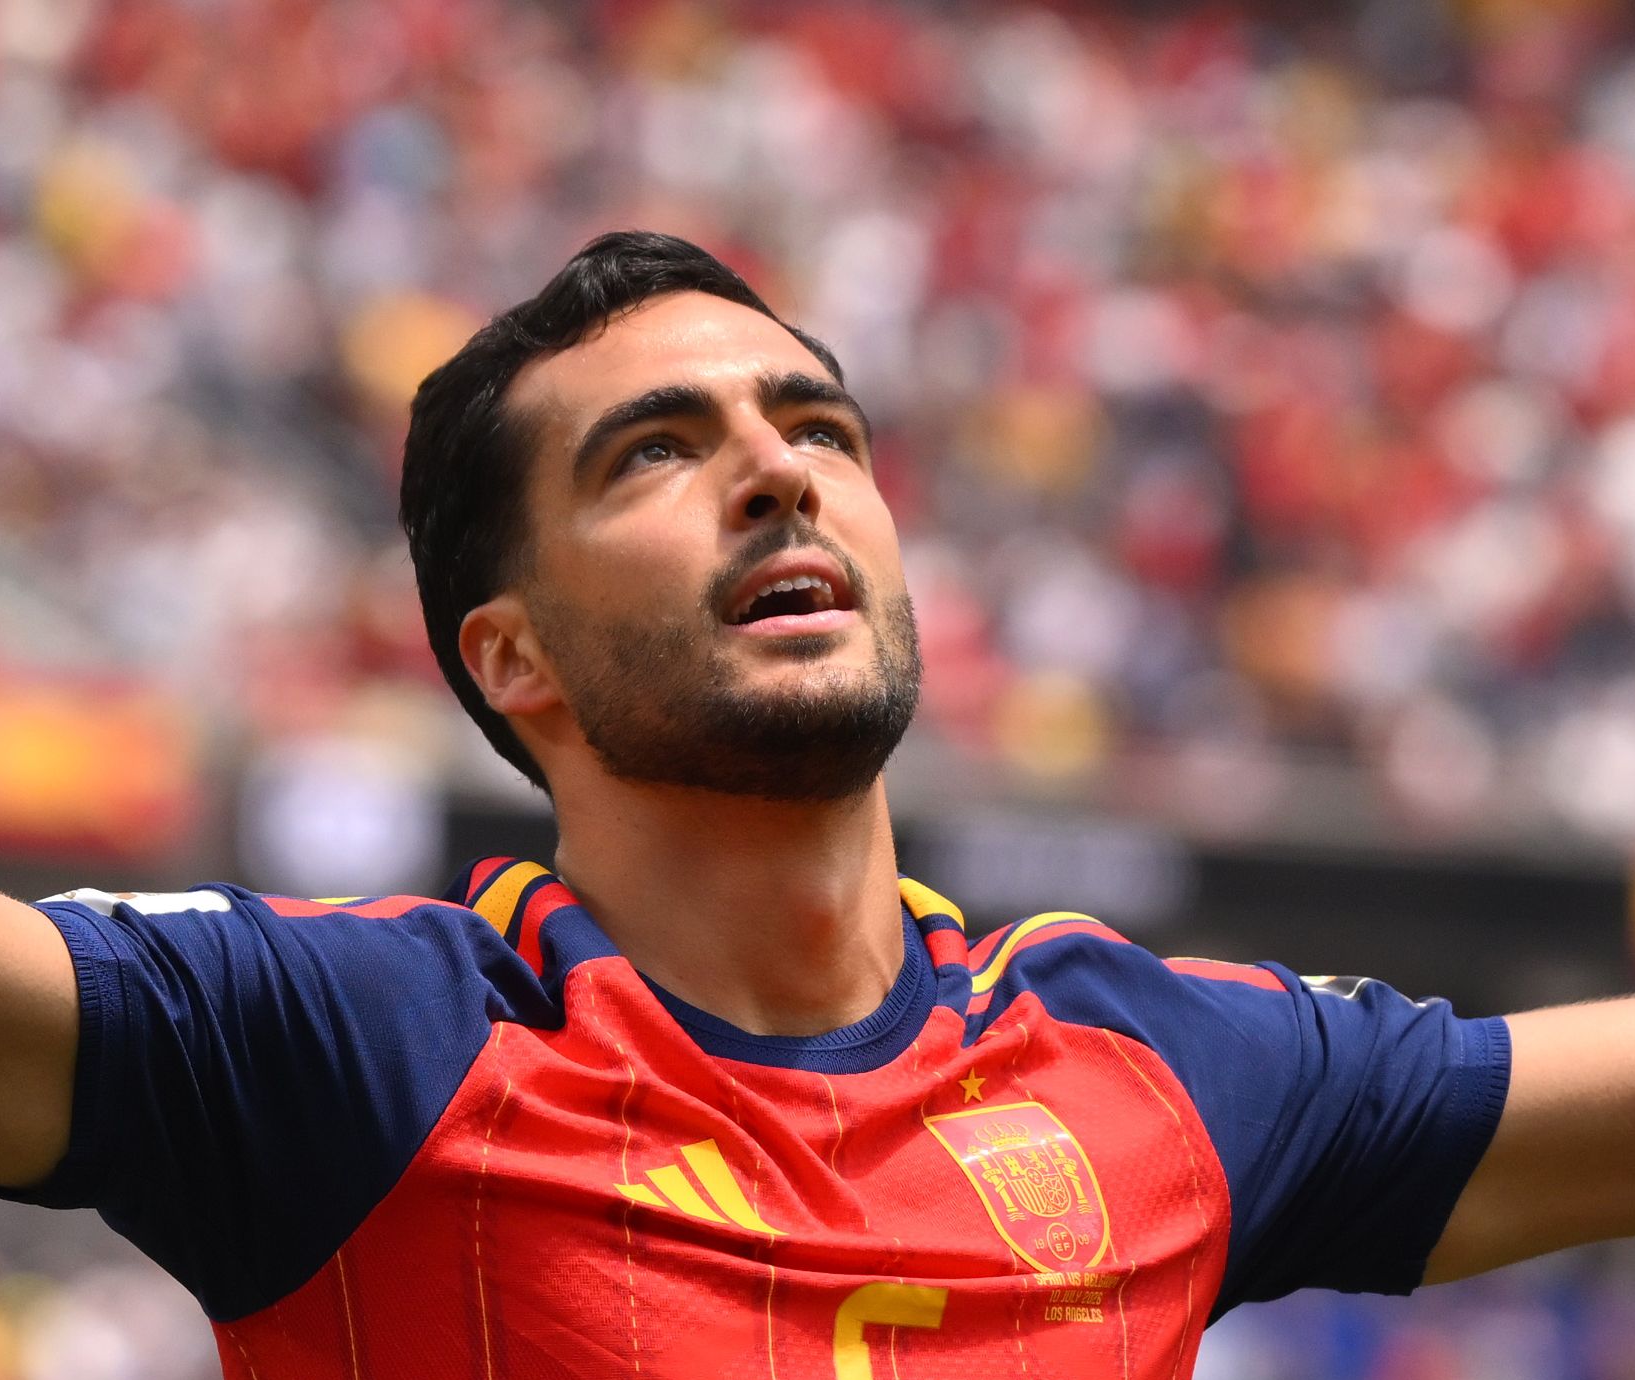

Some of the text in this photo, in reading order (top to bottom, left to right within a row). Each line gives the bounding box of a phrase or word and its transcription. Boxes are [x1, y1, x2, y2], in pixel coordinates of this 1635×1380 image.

[1035, 1234, 1089, 1249] 19 09
[1045, 1307, 1104, 1323] LOS ANGELES
